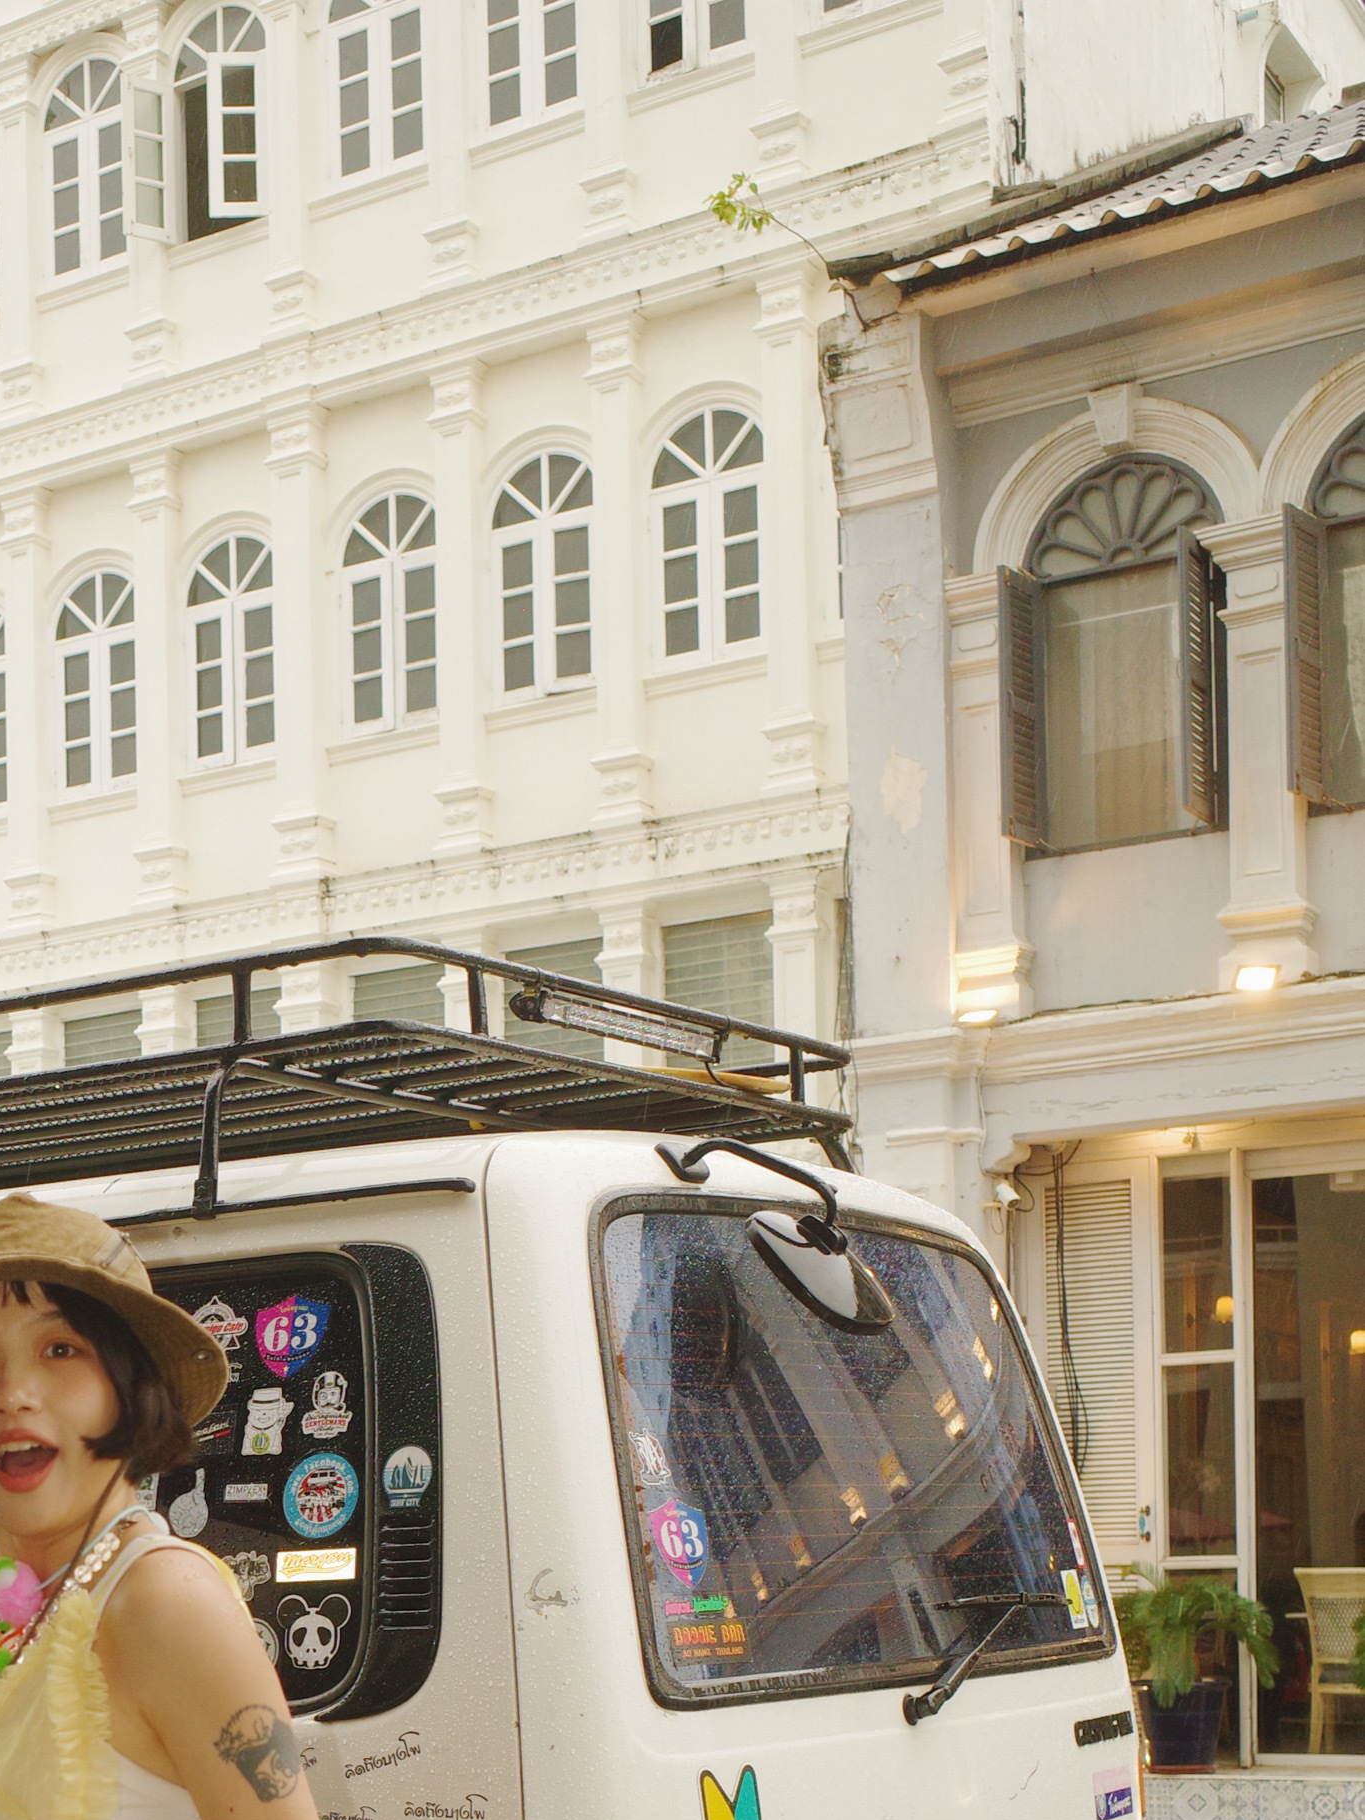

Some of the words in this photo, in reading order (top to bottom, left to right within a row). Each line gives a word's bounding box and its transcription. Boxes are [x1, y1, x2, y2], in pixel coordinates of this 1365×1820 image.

[264, 1313, 318, 1351] 63
[661, 1519, 704, 1558] 63
[721, 1624, 746, 1643] BAR
[715, 1646, 744, 1656] THAILAND
